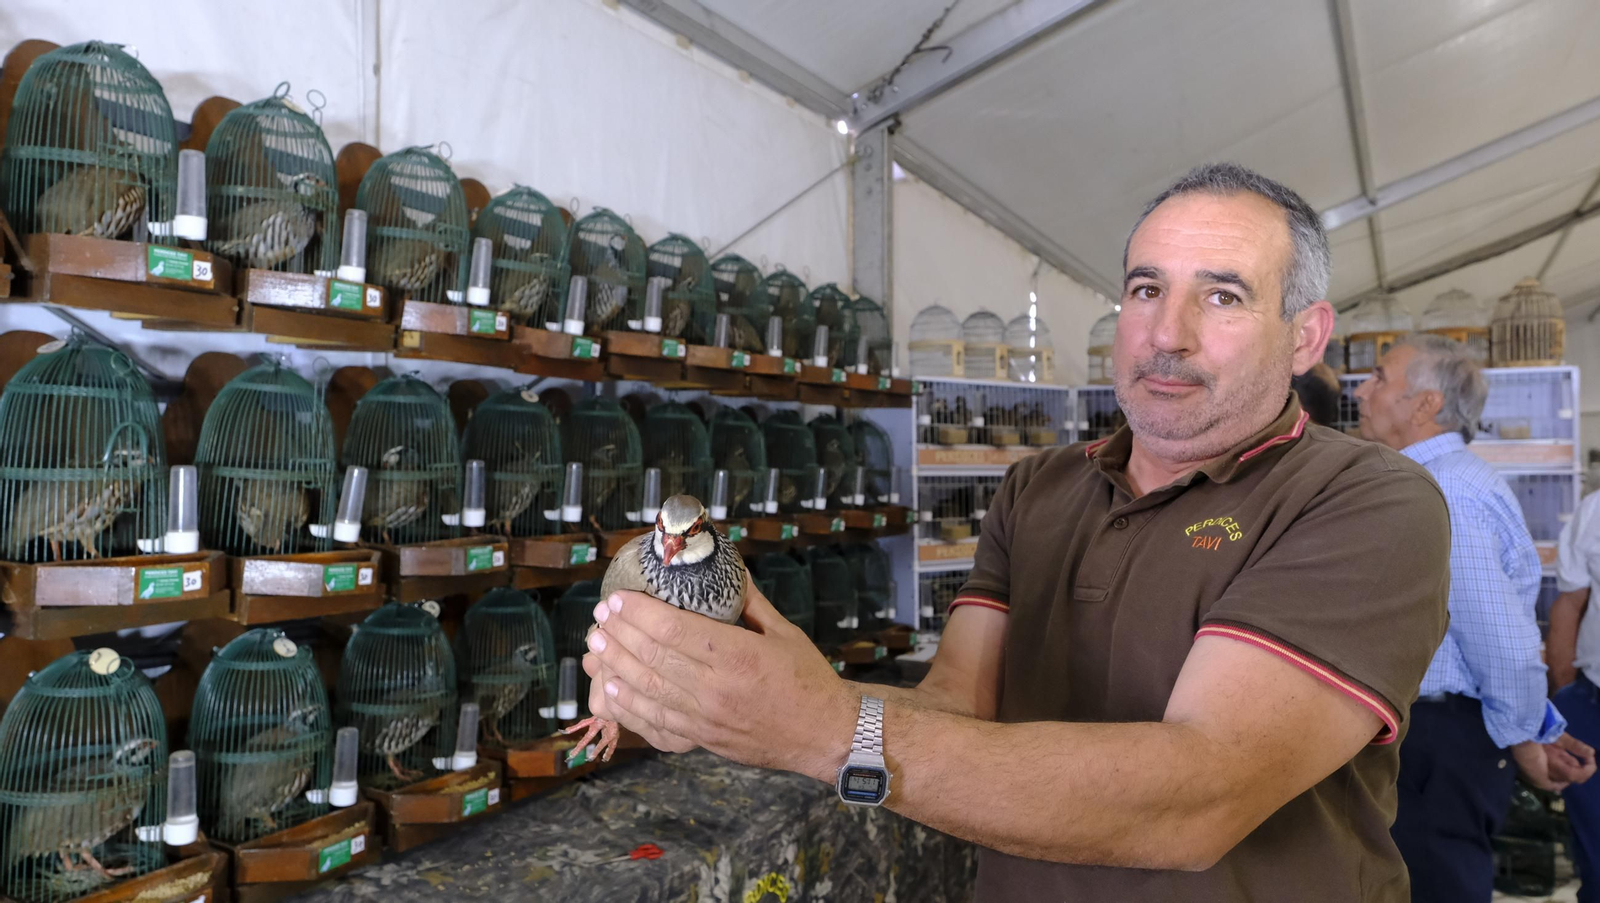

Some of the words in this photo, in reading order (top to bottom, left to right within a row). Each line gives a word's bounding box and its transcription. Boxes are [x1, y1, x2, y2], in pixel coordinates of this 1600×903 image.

[196, 264, 208, 278] 30
[1185, 517, 1243, 541] PERDICES
[1192, 535, 1222, 551] TAVI
[185, 577, 197, 588] 30
